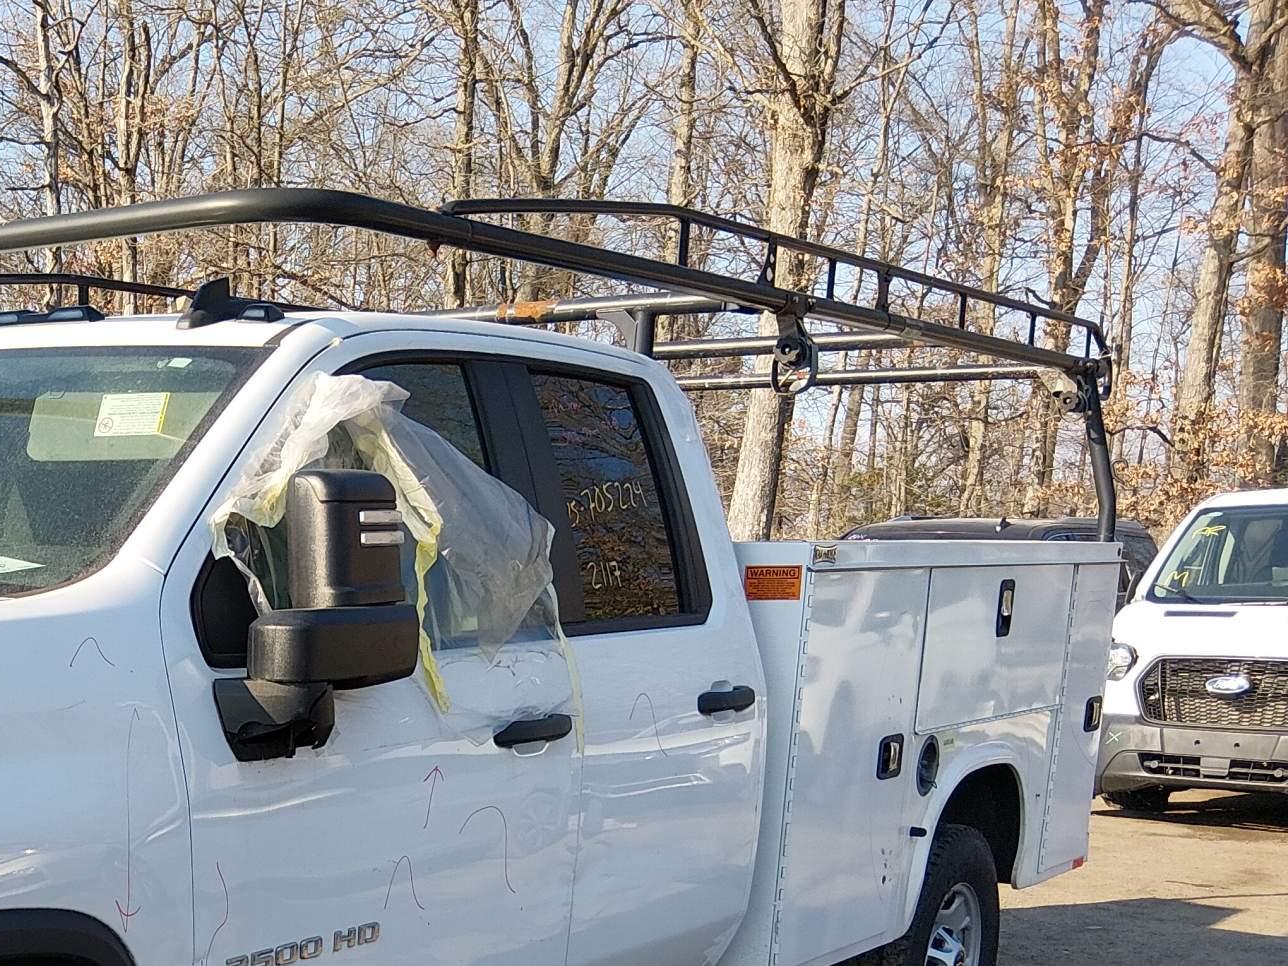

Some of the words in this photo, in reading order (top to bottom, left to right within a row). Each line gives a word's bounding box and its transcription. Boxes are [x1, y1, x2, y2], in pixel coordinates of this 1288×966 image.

[587, 561, 622, 589] 2117
[750, 568, 797, 578] WARNING
[333, 921, 381, 953] HD
